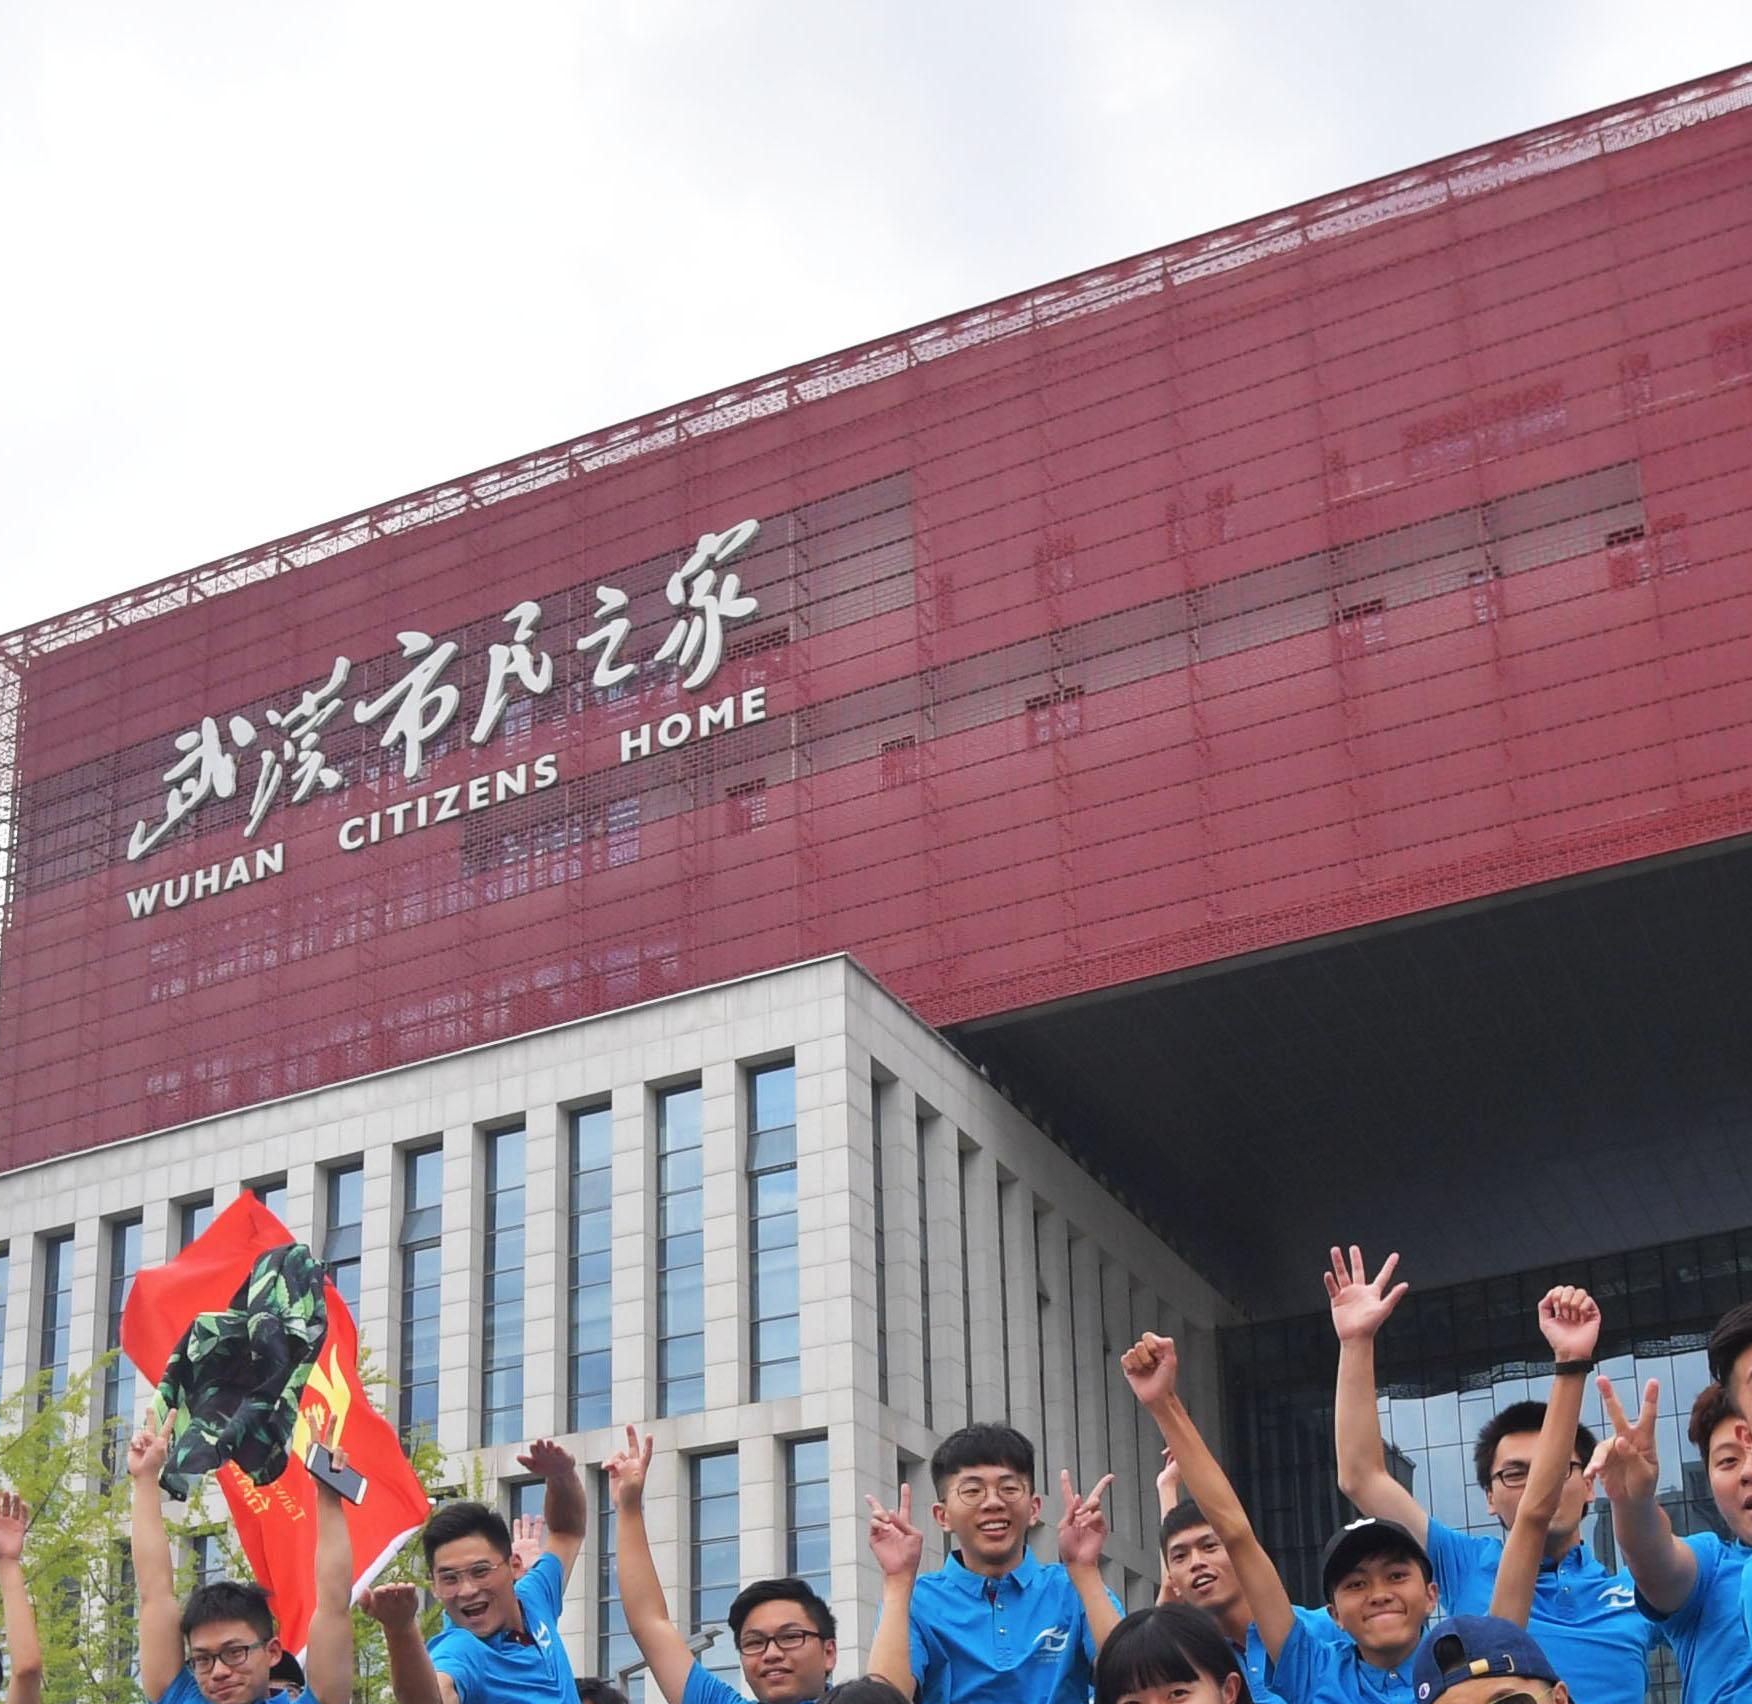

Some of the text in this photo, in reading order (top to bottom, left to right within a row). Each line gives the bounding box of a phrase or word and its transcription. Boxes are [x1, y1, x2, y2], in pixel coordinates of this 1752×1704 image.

[126, 687, 766, 920] WUHAN CITIZENS HOME
